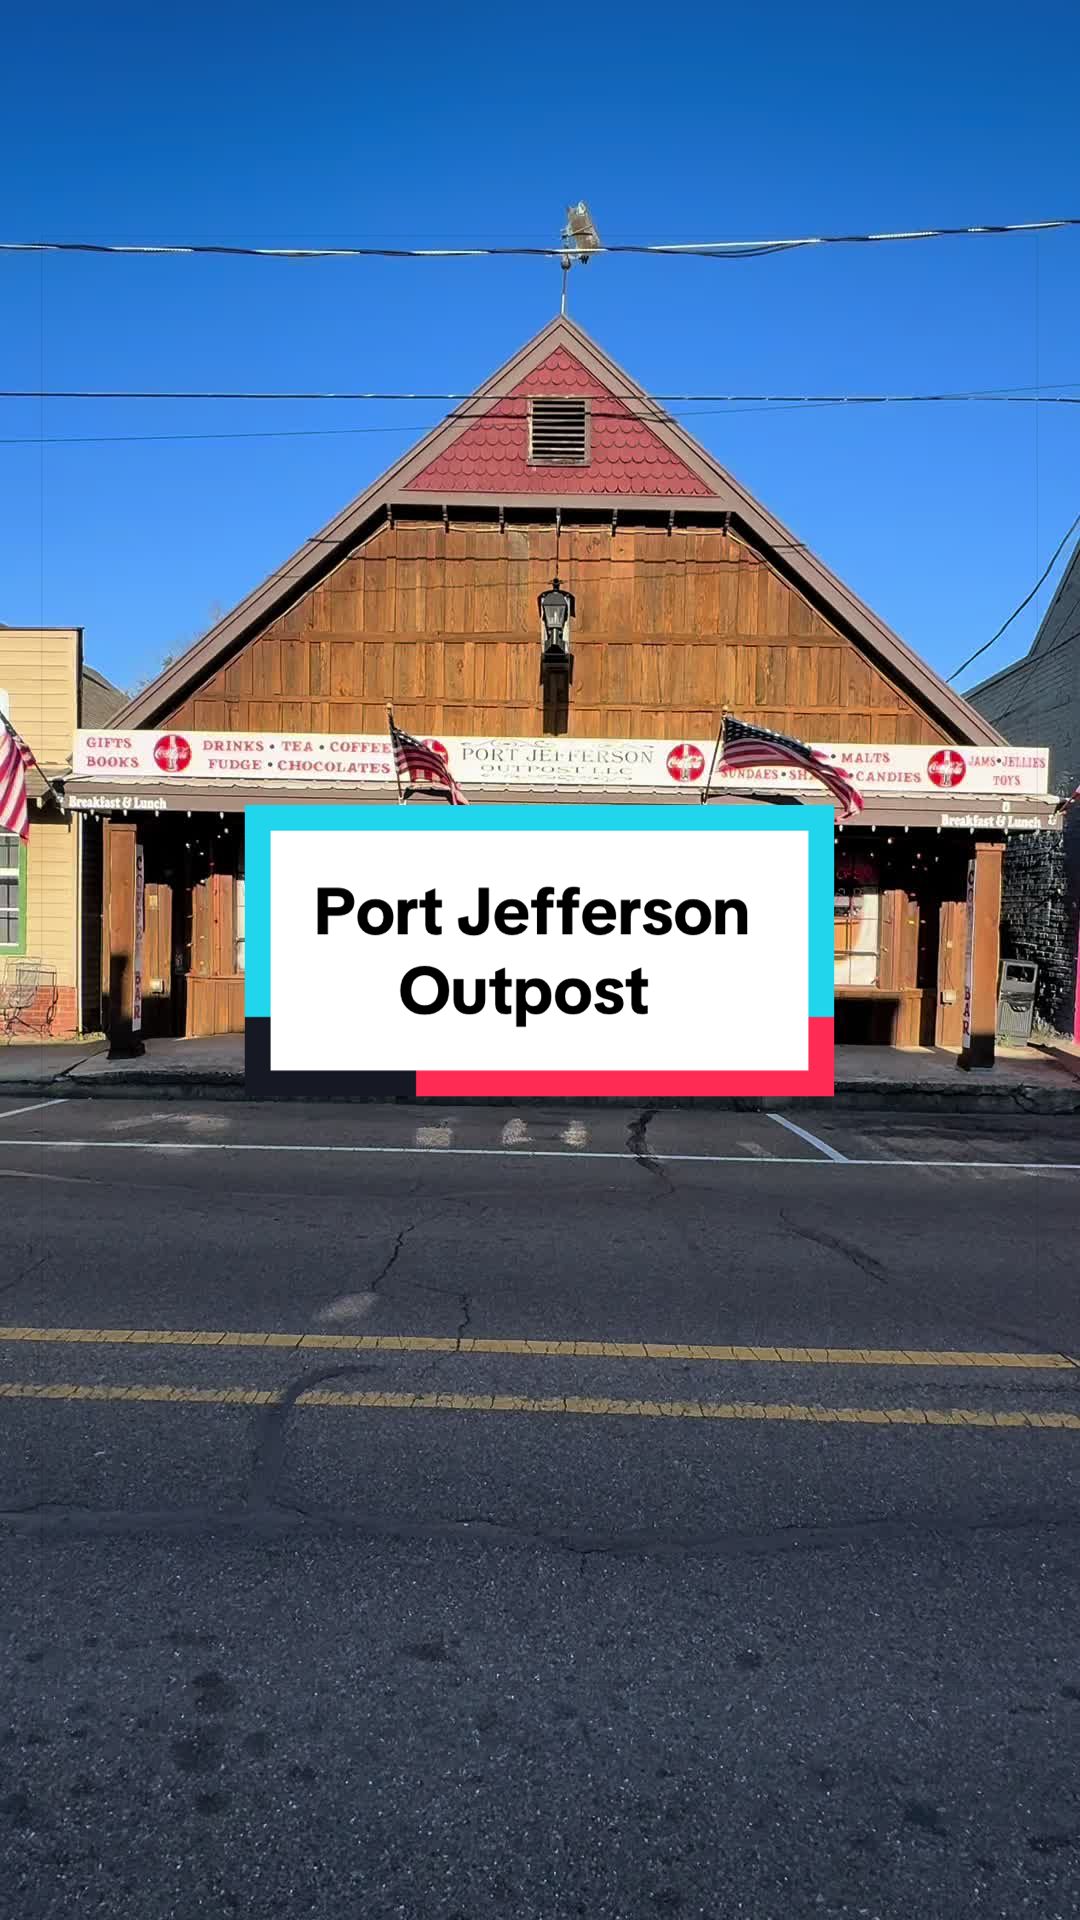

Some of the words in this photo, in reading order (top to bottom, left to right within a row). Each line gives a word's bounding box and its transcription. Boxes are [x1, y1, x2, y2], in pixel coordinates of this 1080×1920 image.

[86, 736, 132, 748] GIFTS
[203, 740, 264, 752] DRINKS
[282, 741, 313, 752] TEA
[330, 742, 391, 753] COFFEE
[462, 748, 518, 761] PORT
[526, 748, 653, 763] JEFFERSON
[841, 753, 890, 763] MALTS
[87, 756, 139, 768] BOOKS
[208, 759, 262, 770] FUDGE
[277, 760, 391, 773] CHOCOLATES
[968, 756, 996, 766] JAMS
[1002, 757, 1046, 768] JELLIES
[481, 765, 583, 774] OUTPOST
[721, 768, 778, 779] SUNDAES
[856, 771, 922, 782] CANDIES
[993, 776, 1020, 785] TOYS
[69, 796, 120, 808] Breakfast
[122, 797, 131, 809] &
[134, 797, 167, 809] Lunch
[941, 814, 994, 827] Breakfast
[996, 815, 1006, 827] &
[1008, 816, 1041, 828] Lunch
